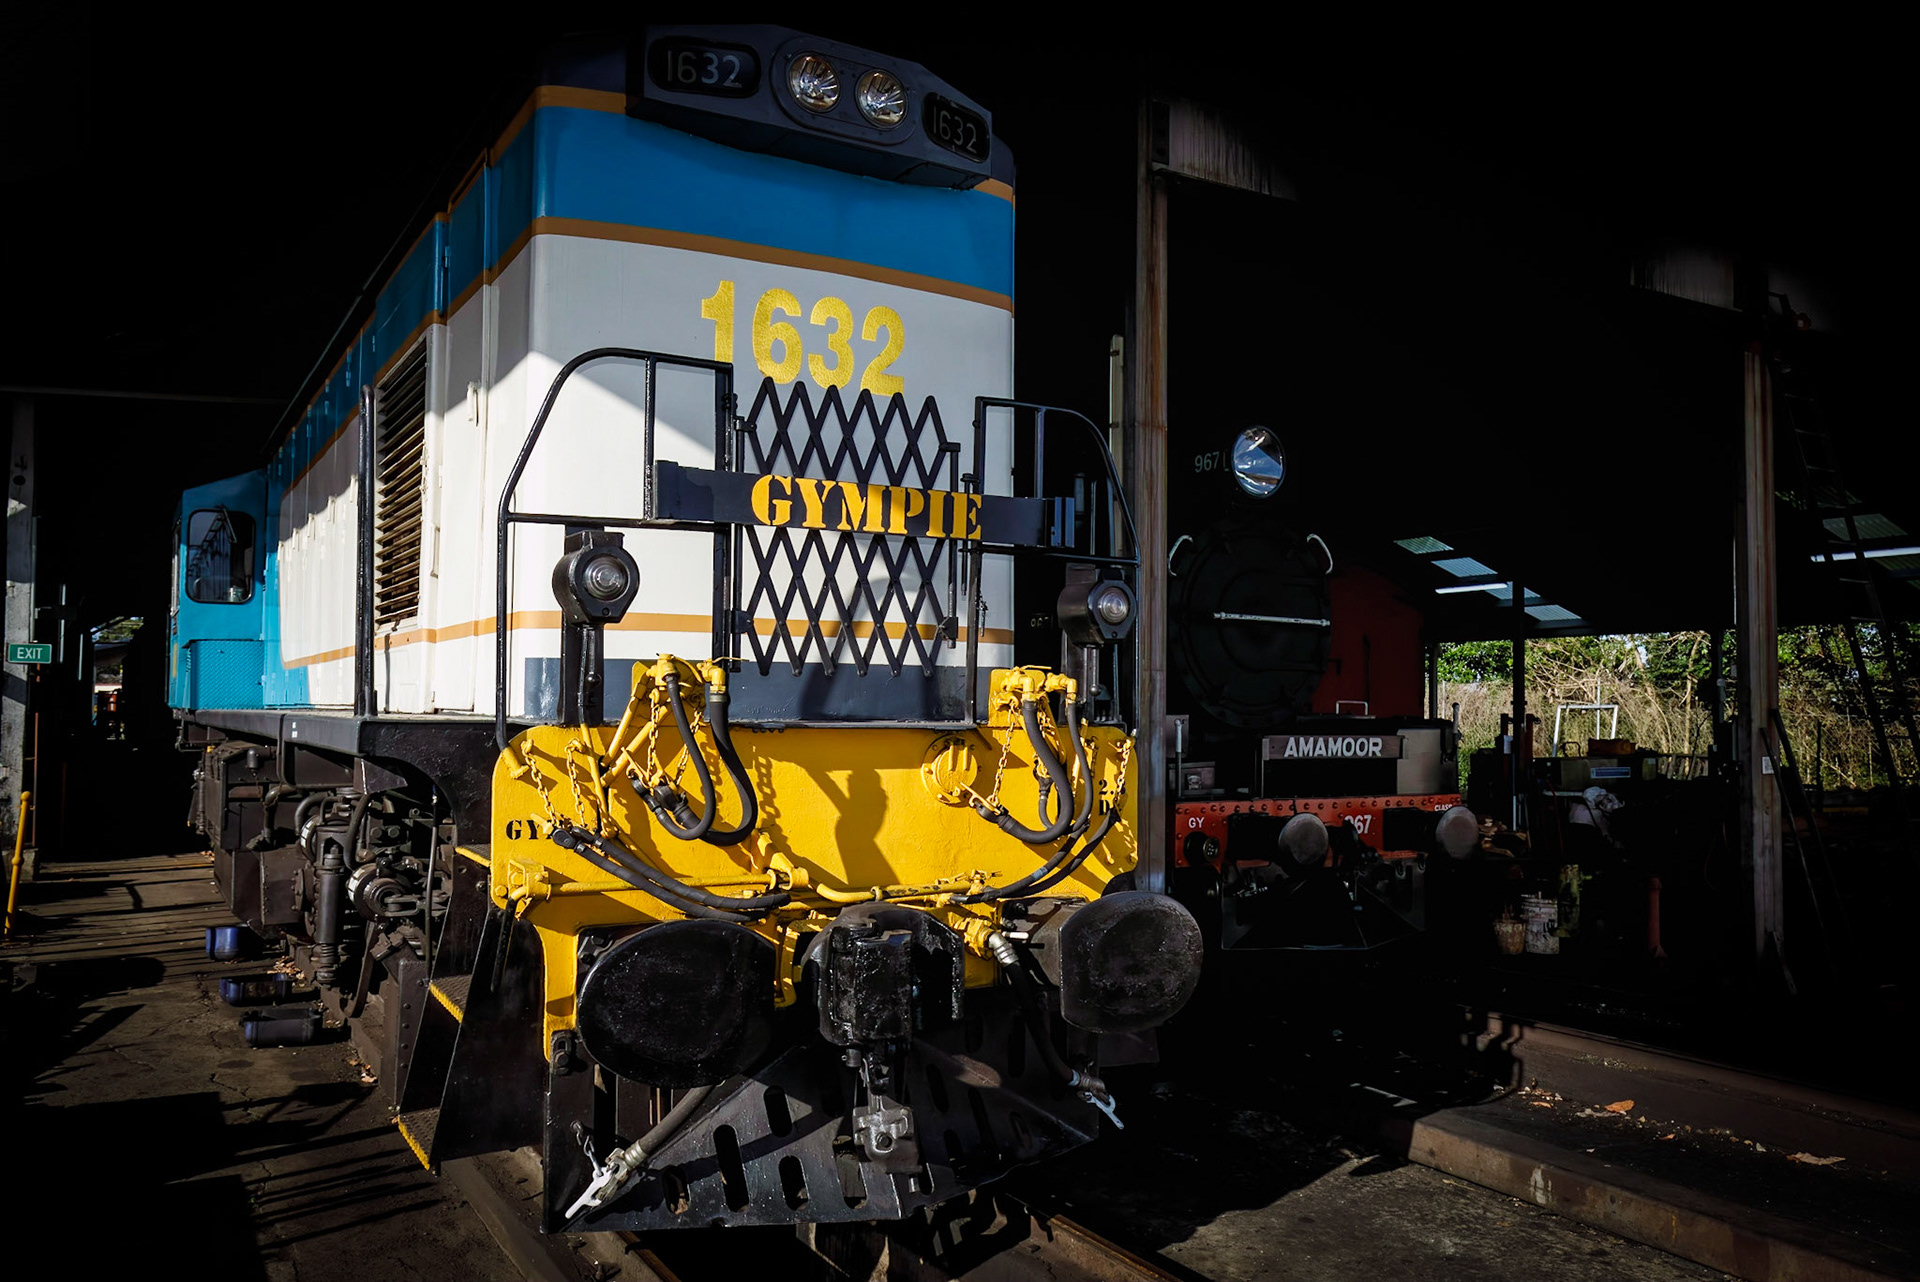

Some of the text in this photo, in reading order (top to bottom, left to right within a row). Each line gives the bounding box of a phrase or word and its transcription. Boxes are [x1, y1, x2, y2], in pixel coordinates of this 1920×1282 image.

[667, 50, 743, 89] 1632
[933, 105, 978, 154] 1632
[701, 280, 905, 396] 1632
[751, 474, 982, 540] GYMPIE
[17, 647, 43, 660] EXIT
[1283, 736, 1383, 758] AMAMOOR
[1188, 817, 1205, 829] GY
